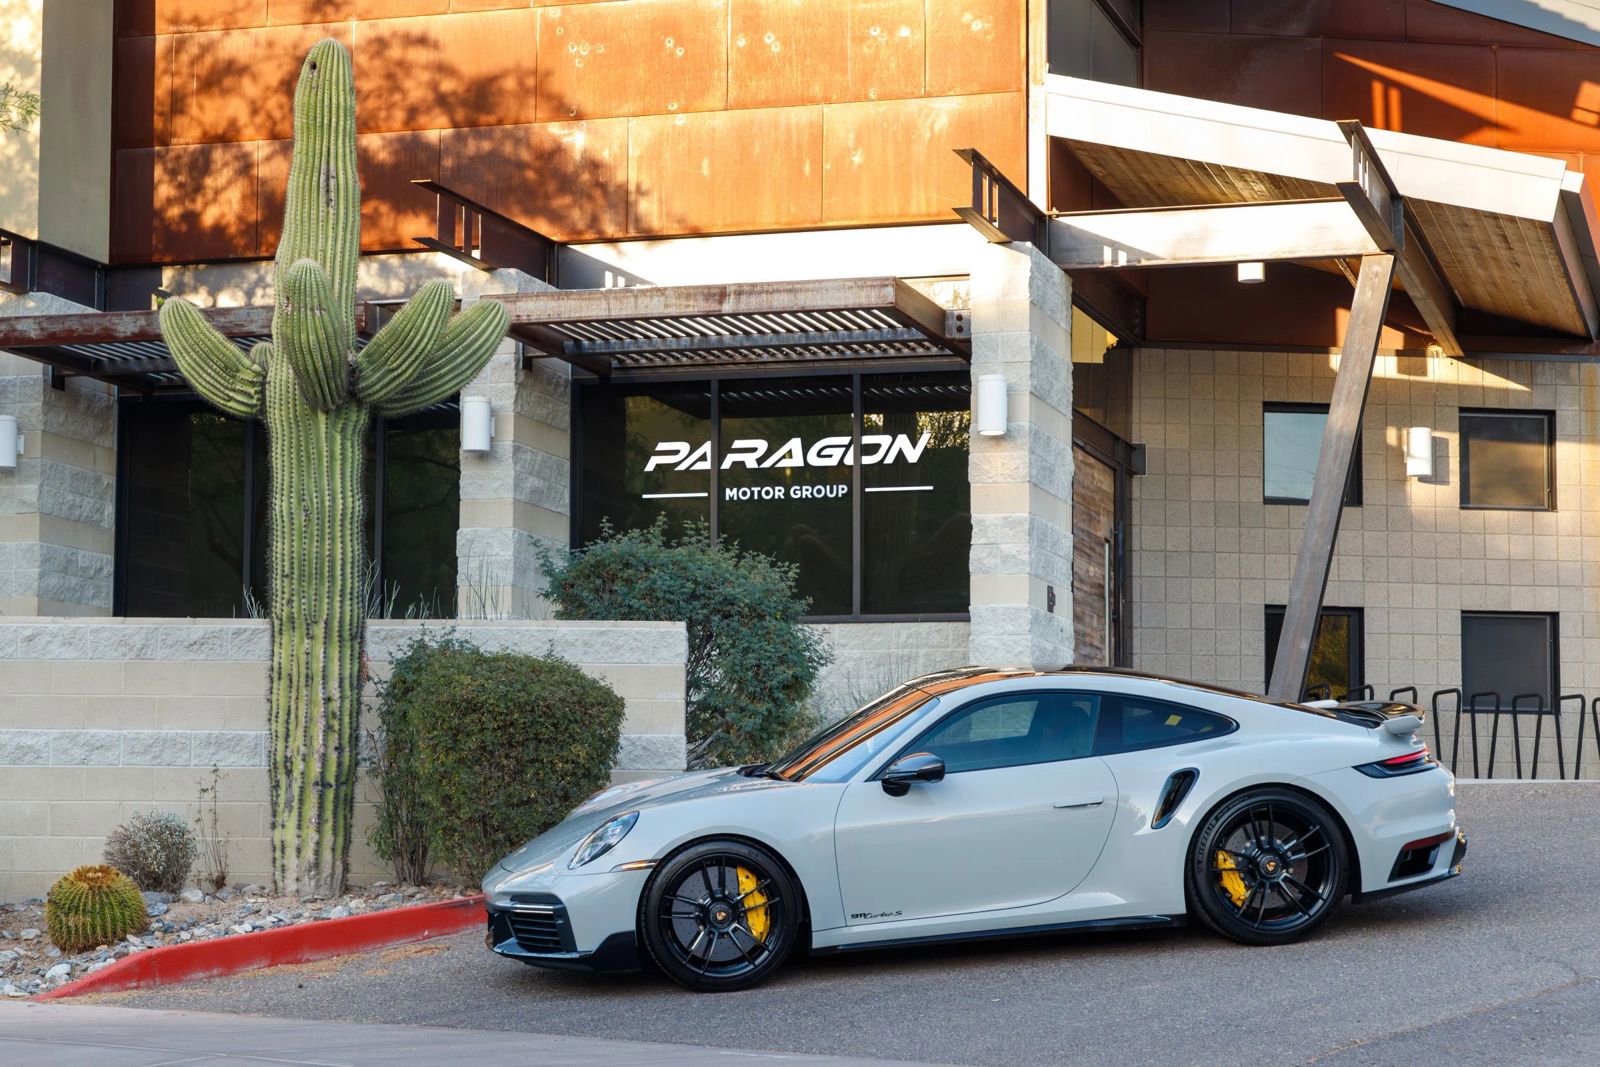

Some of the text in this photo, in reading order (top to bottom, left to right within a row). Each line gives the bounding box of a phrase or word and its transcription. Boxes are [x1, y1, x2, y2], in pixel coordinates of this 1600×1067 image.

[643, 432, 931, 472] PARAGON
[725, 484, 848, 501] MOTOR GROUP
[1198, 818, 1217, 862] MICHELIN
